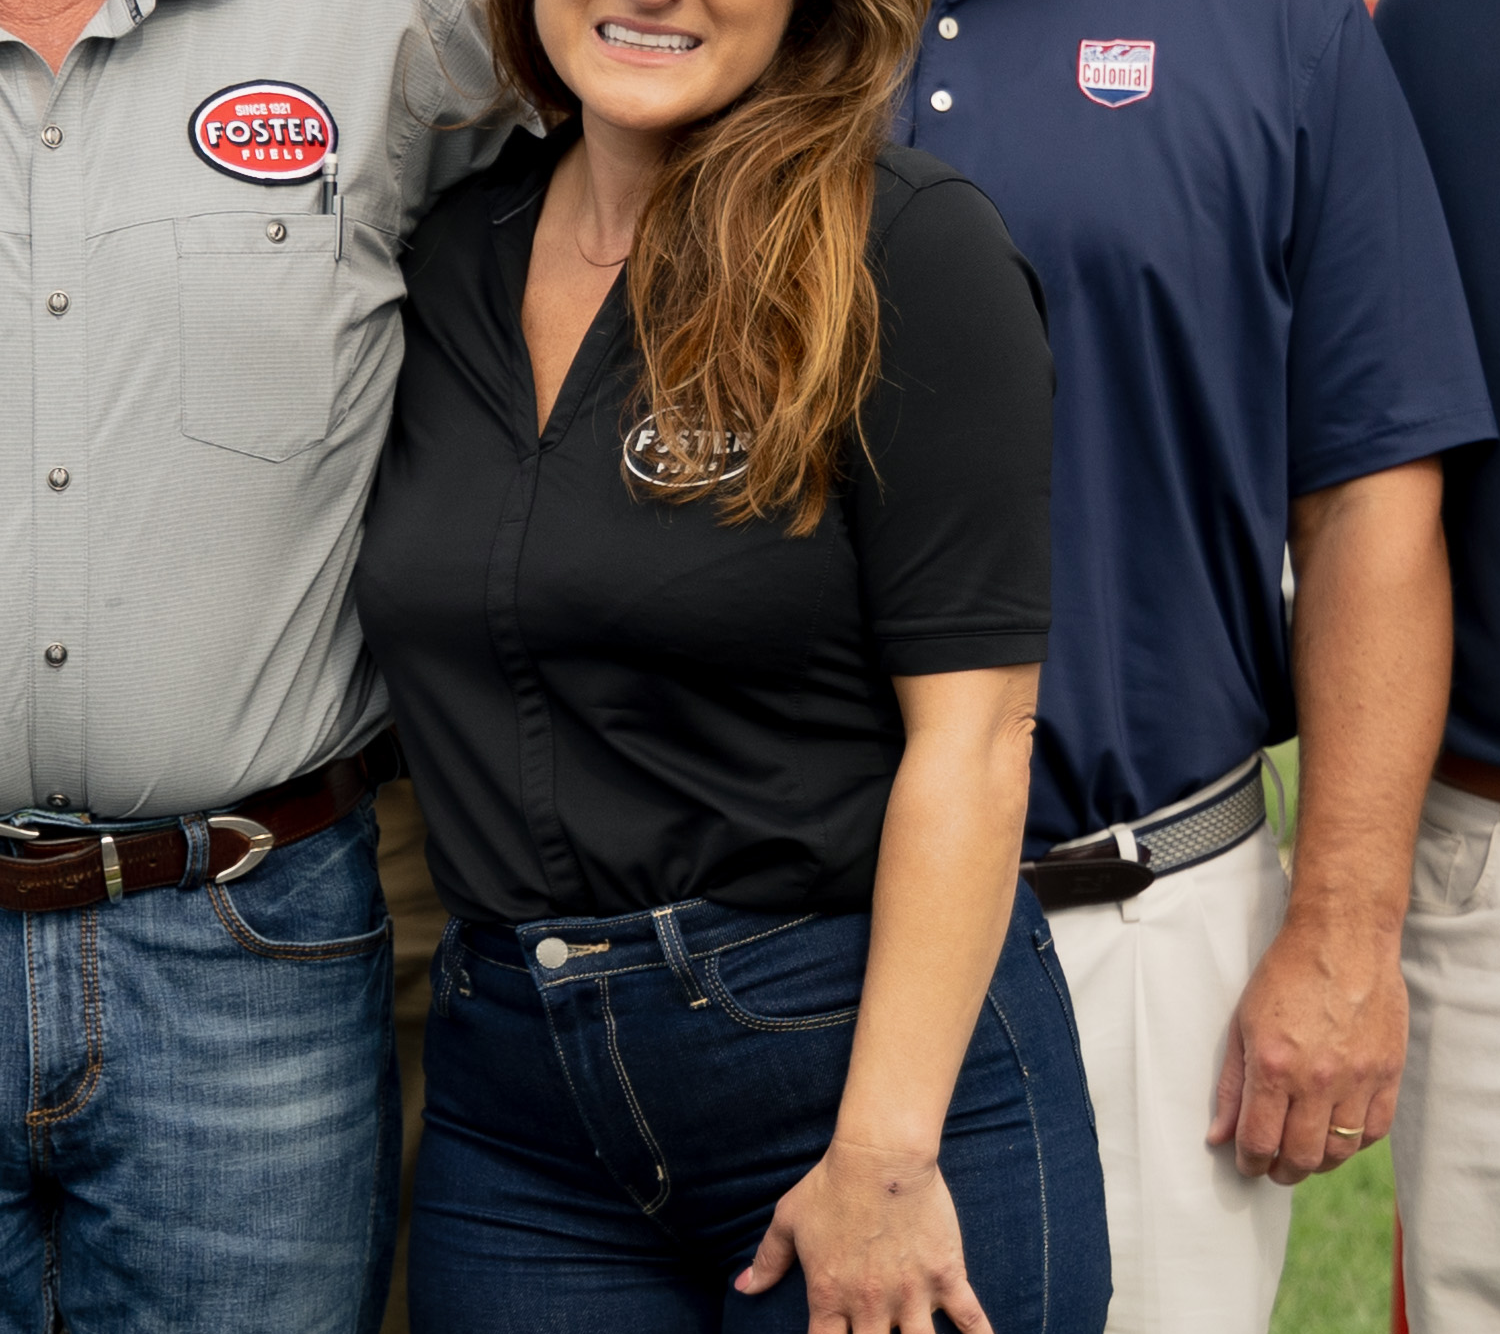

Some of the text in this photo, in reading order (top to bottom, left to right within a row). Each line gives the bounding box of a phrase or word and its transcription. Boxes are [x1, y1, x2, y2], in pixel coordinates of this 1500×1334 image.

[1083, 63, 1147, 87] Colonial
[235, 103, 291, 116] SINCE 1921
[206, 118, 325, 148] FOSTER
[241, 148, 304, 161] FUELS
